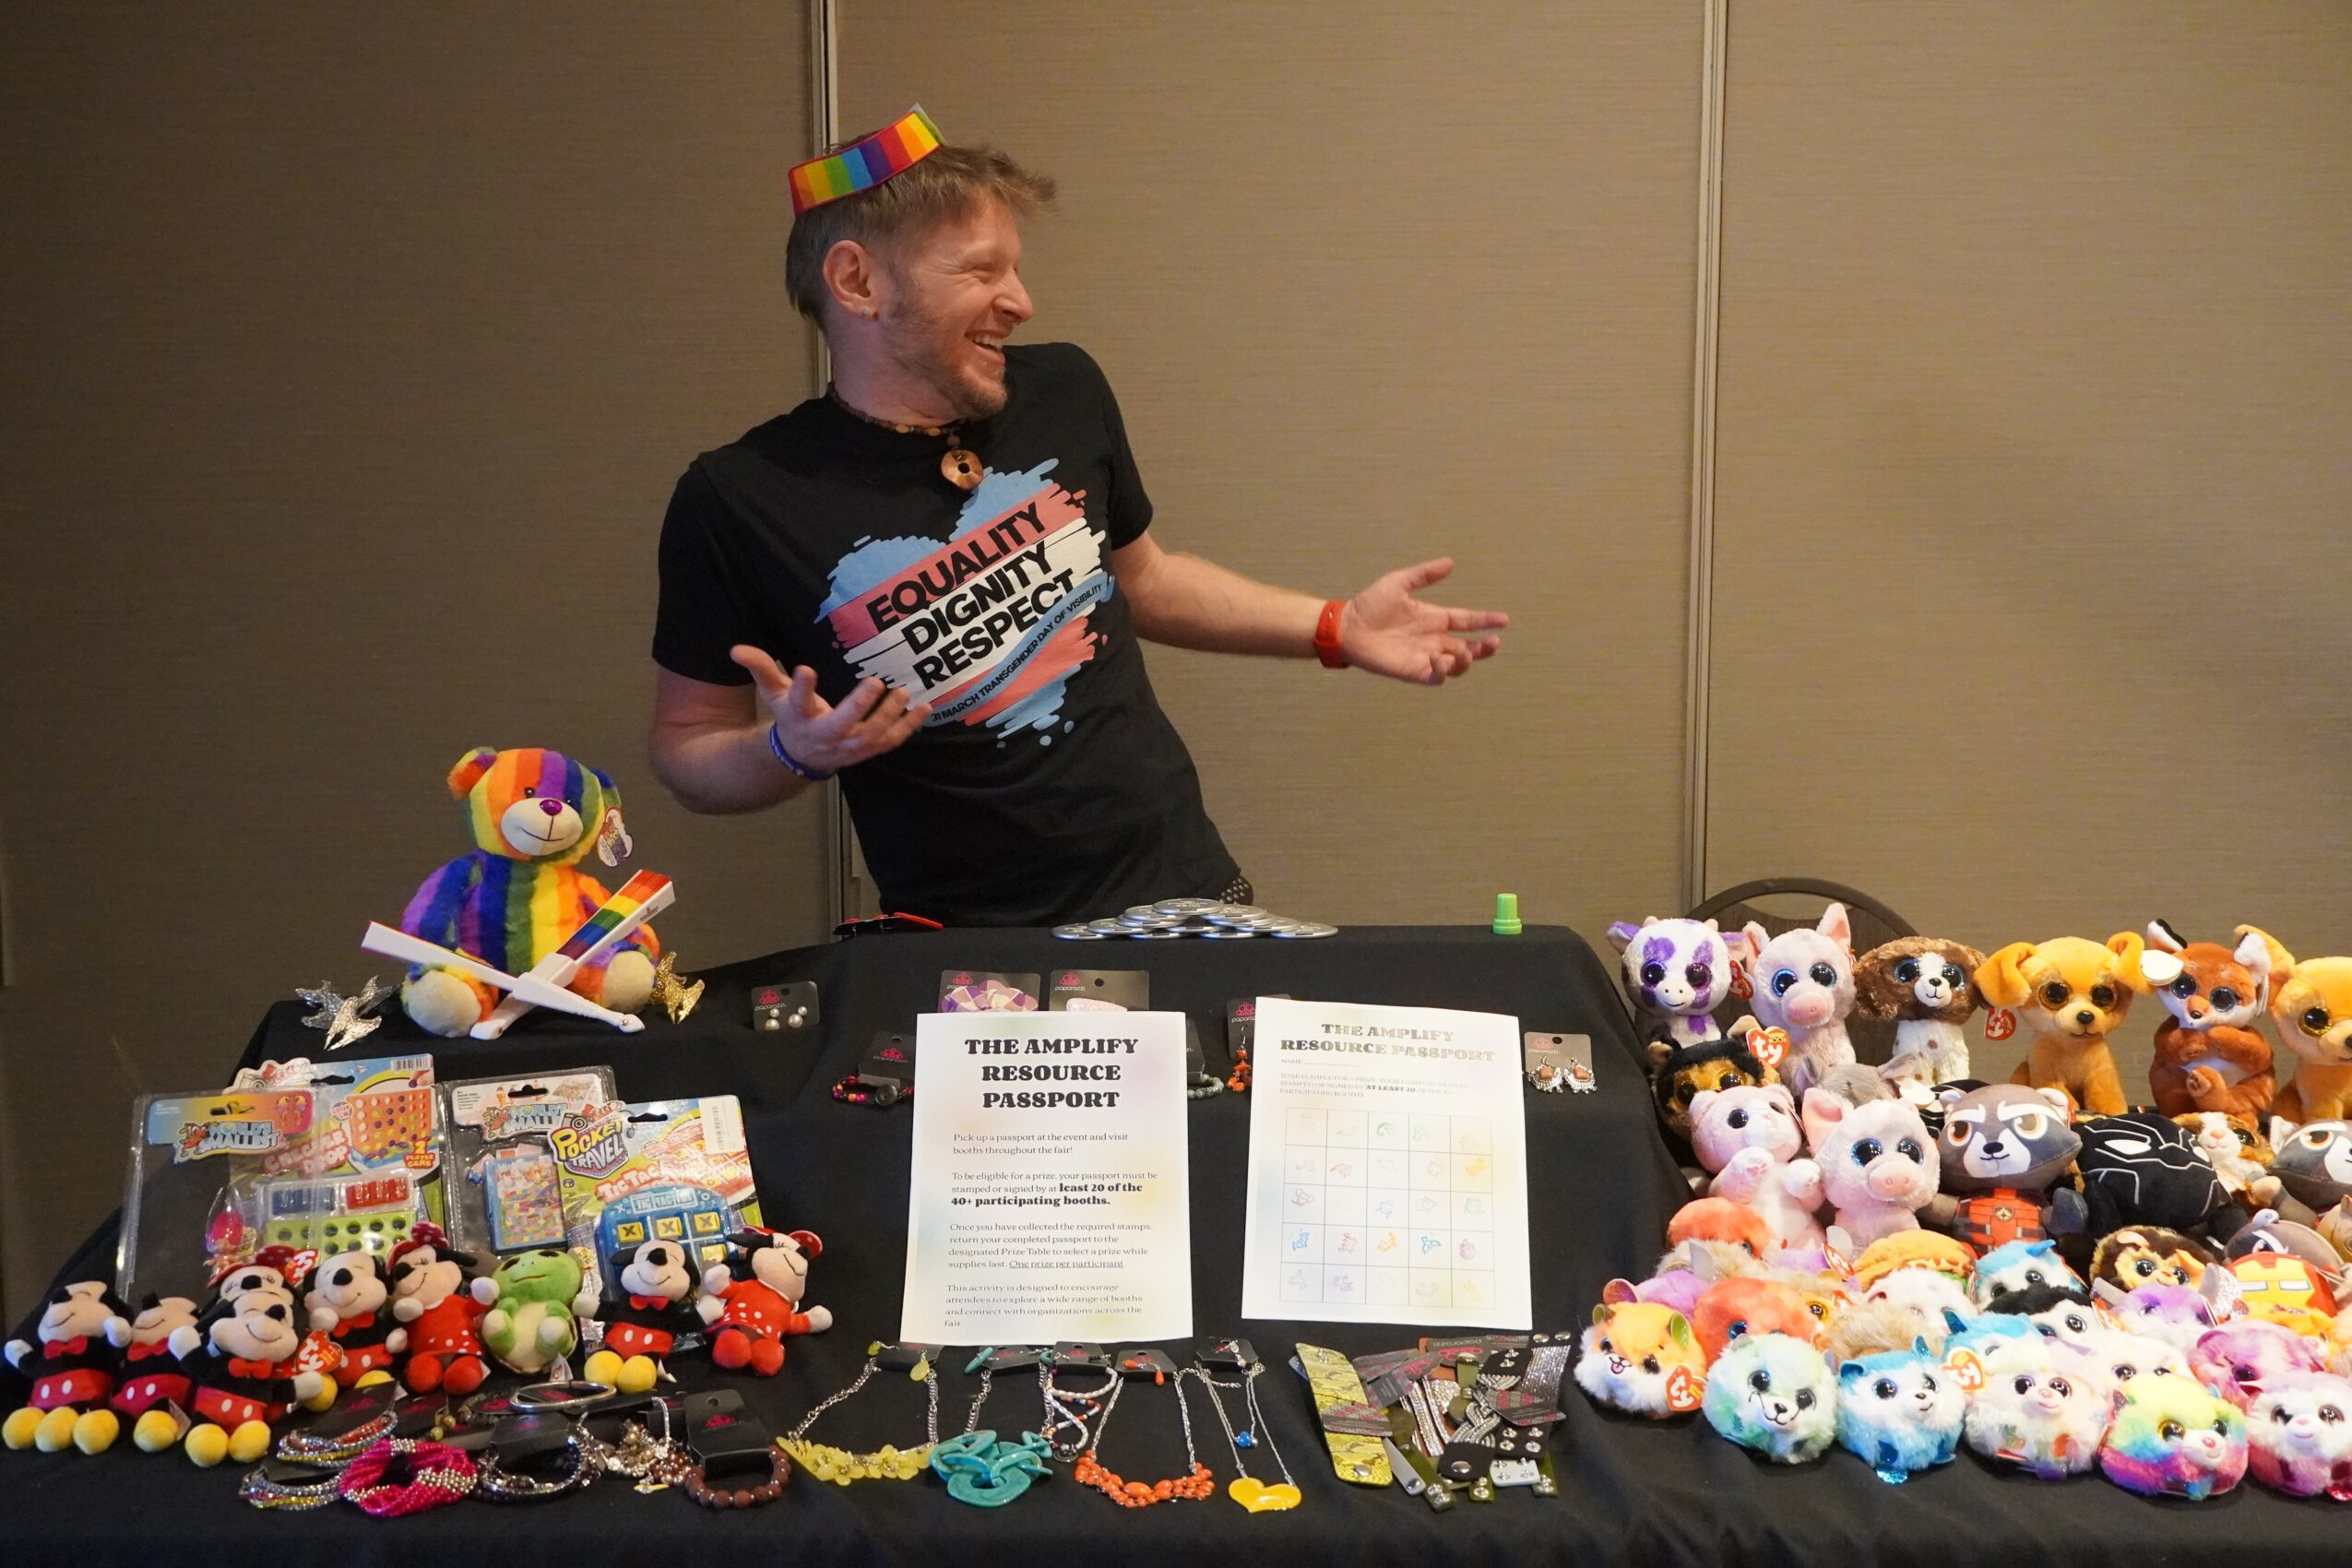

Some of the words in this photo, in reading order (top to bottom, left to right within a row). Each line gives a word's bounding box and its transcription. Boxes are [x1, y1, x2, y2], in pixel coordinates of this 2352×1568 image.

[865, 502, 1045, 632] EQUALITY
[901, 540, 1052, 656] DIGNITY
[913, 567, 1076, 690] RESPECT
[941, 695, 980, 720] MARCH
[978, 639, 1038, 698] TRANSGENDER
[1038, 623, 1054, 645] DAY
[1053, 609, 1065, 624] OF
[1065, 583, 1102, 613] VISIBILITY
[1321, 1023, 1362, 1037] THE
[1367, 1026, 1454, 1041] AMPLIFY
[965, 1039, 1019, 1054] THE
[1024, 1038, 1138, 1054] AMPLIFY
[1280, 1039, 1387, 1054] RESOURCE
[1391, 1045, 1496, 1062] PASSPORT
[1752, 1036, 1784, 1064] ty
[981, 1064, 1121, 1080] RESOURCE
[982, 1092, 1120, 1108] PASSPORT
[194, 1131, 280, 1154] SMALLEST
[552, 1120, 624, 1160] POCKET
[954, 1133, 974, 1142] Pick
[976, 1134, 988, 1143] up
[996, 1134, 1034, 1144] passport
[1047, 1133, 1062, 1141] the
[1089, 1133, 1107, 1141] and
[1108, 1132, 1128, 1141] visit
[414, 1140, 426, 1154] 2
[572, 1134, 624, 1168] TRAVEL
[953, 1146, 983, 1154] booths
[985, 1146, 1036, 1156] throughout
[1038, 1145, 1052, 1154] the
[1053, 1145, 1072, 1154] fair!
[598, 1180, 629, 1198] TIC
[624, 1164, 659, 1187] TAC
[963, 1171, 974, 1180] be
[976, 1171, 1008, 1182] eligible
[1010, 1171, 1023, 1180] for
[1058, 1172, 1079, 1182] your
[1081, 1172, 1120, 1182] passport
[1146, 1171, 1158, 1180] be
[951, 1184, 991, 1194] stamped
[1004, 1184, 1034, 1194] signed
[1036, 1184, 1046, 1194] by
[1059, 1182, 1088, 1193] least
[1091, 1183, 1104, 1192] 20
[1107, 1182, 1121, 1192] of
[1123, 1182, 1142, 1192] the
[951, 1196, 971, 1206] 40+
[975, 1196, 1060, 1206] participating
[1063, 1196, 1110, 1206] booths.
[949, 1222, 974, 1231] Once
[976, 1224, 992, 1233] you
[994, 1222, 1016, 1231] have
[1018, 1222, 1058, 1231] collected
[1060, 1222, 1075, 1231] the
[1076, 1222, 1115, 1233] required
[949, 1235, 979, 1243] return
[980, 1236, 1001, 1245] your
[1003, 1234, 1050, 1245] completed
[1051, 1235, 1091, 1245] passport
[1094, 1235, 1103, 1243] to
[1103, 1234, 1119, 1243] the
[948, 1247, 999, 1257] designated
[1001, 1247, 1025, 1255] Prize
[1028, 1247, 1051, 1255] Table
[1063, 1247, 1088, 1255] select
[1098, 1247, 1121, 1257] prize
[1123, 1246, 1148, 1255] while
[948, 1259, 987, 1269] supplies
[1009, 1260, 1029, 1268] One
[1030, 1259, 1053, 1270] prize
[1055, 1260, 1071, 1270] per
[946, 1284, 967, 1292] This
[968, 1284, 1004, 1293] activity
[1016, 1283, 1058, 1293] designed
[1071, 1285, 1119, 1293] encourage
[945, 1295, 991, 1303] attendees
[992, 1295, 1003, 1303] to
[1003, 1295, 1038, 1305] explore
[1048, 1294, 1070, 1303] wide
[1071, 1297, 1098, 1305] range
[1099, 1294, 1109, 1303] of
[1111, 1293, 1142, 1302] booths
[944, 1307, 963, 1316] and
[965, 1308, 1001, 1316] connect
[1004, 1306, 1026, 1315] with
[1028, 1306, 1092, 1317] organizations
[1127, 1305, 1142, 1314] the
[299, 1338, 325, 1372] ty
[1669, 1373, 1695, 1408] ty
